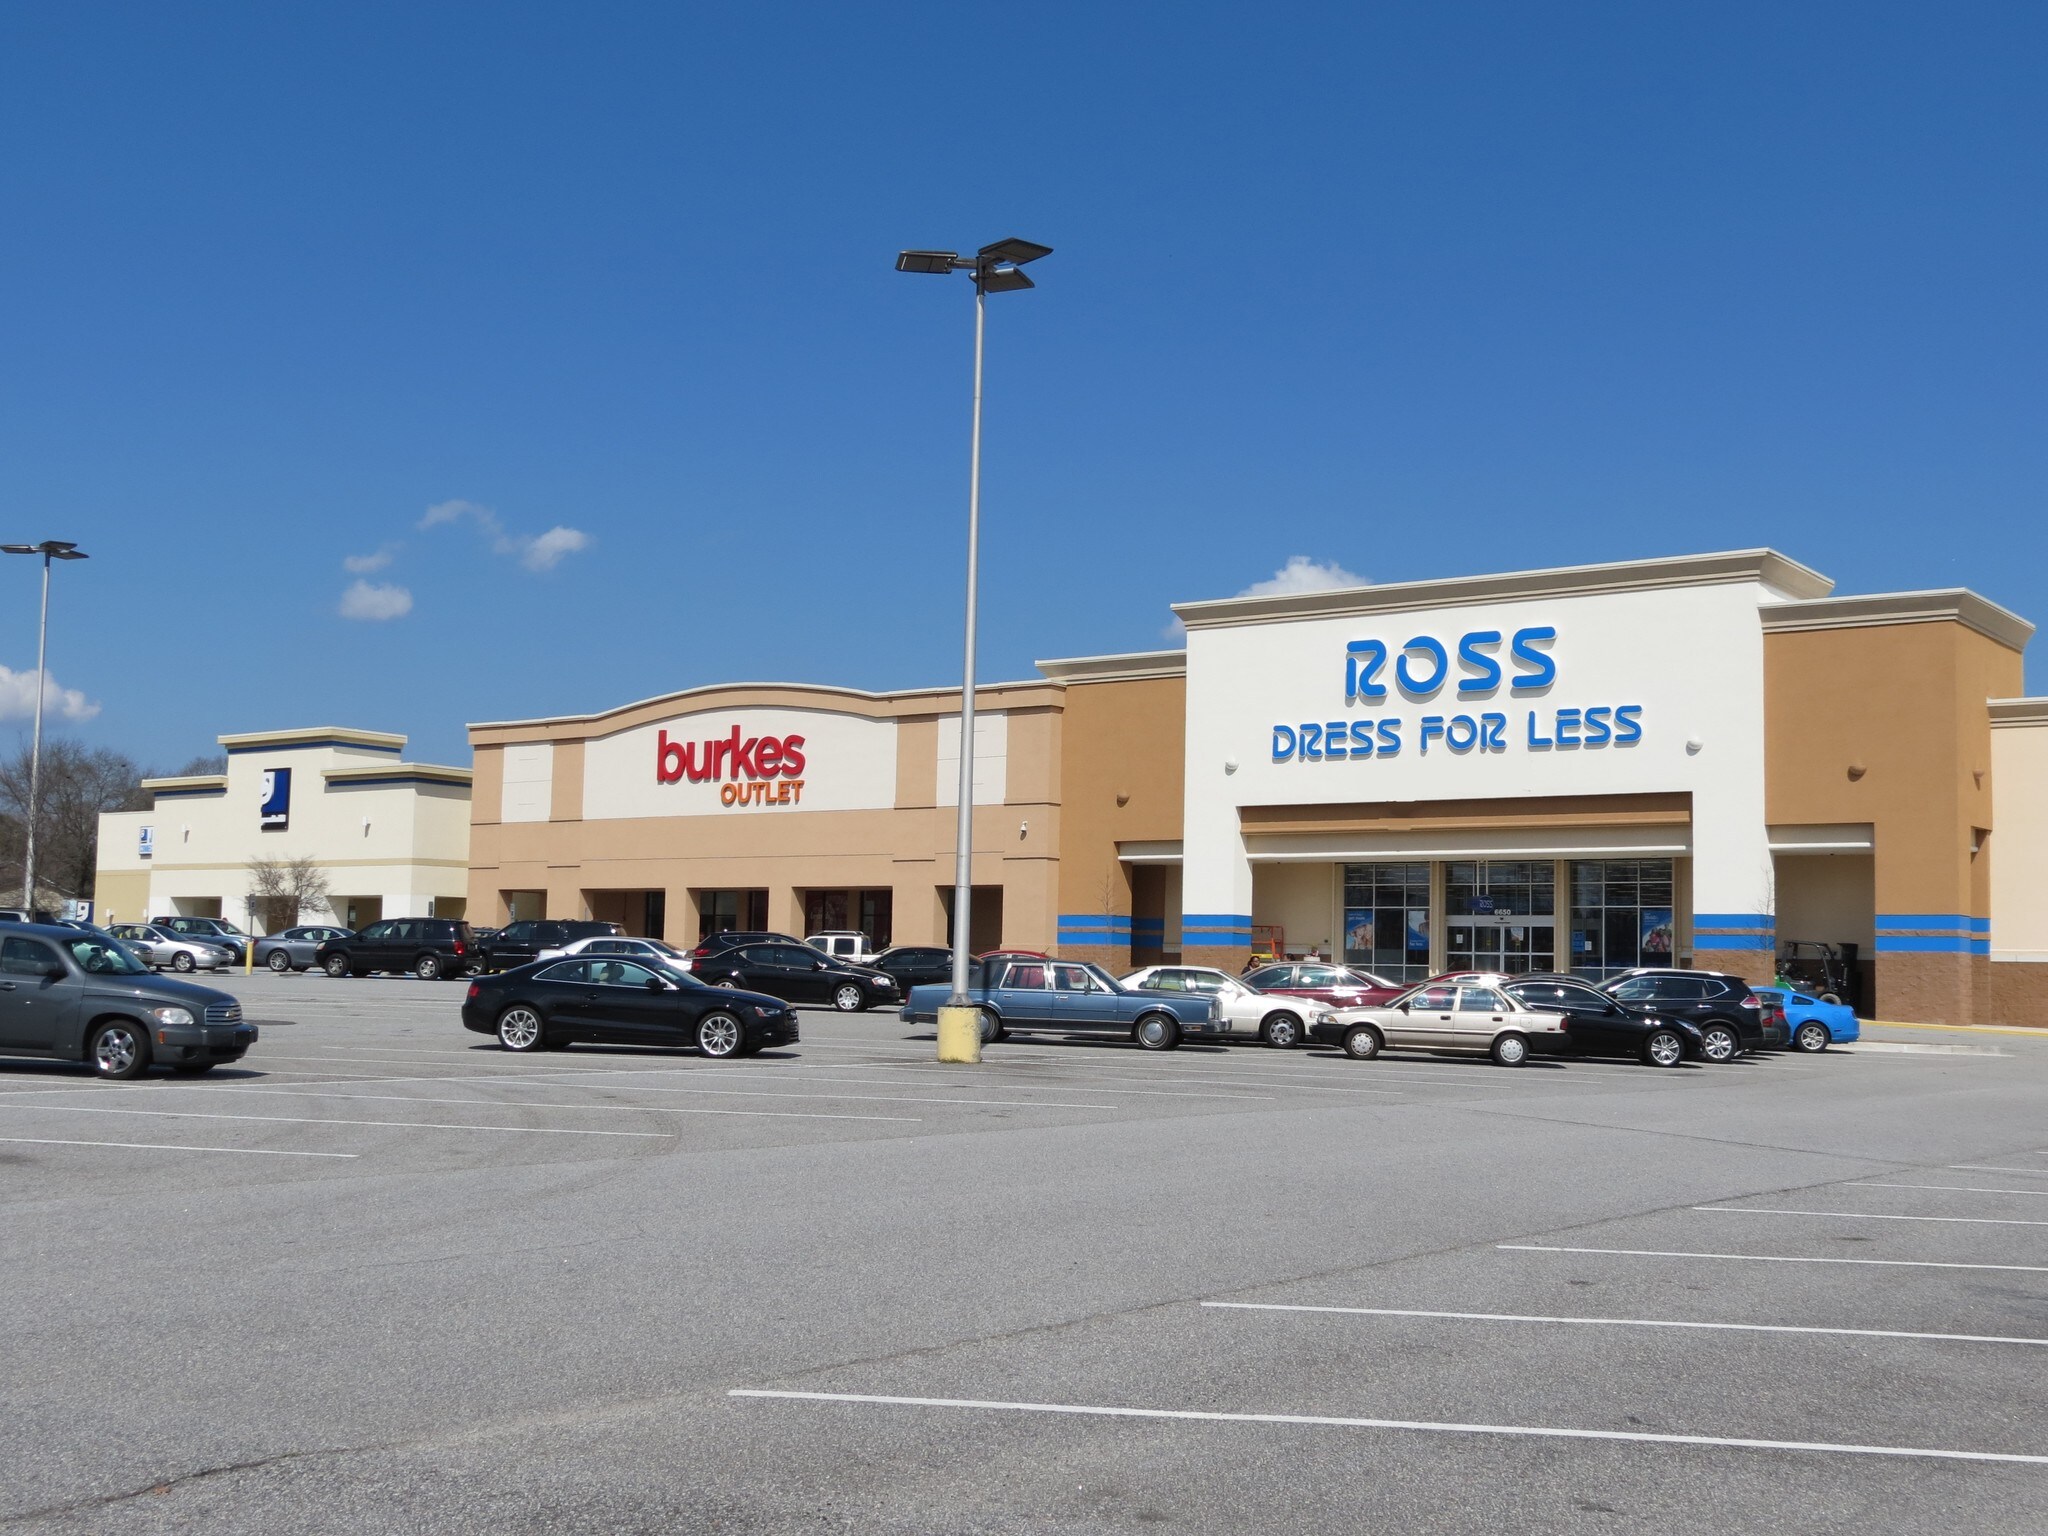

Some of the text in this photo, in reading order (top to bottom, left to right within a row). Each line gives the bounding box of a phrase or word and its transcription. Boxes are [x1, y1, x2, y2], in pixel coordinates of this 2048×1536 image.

[1345, 626, 1557, 698] ROSS
[657, 724, 806, 782] burkes
[1272, 705, 1643, 759] DRESS FOR LESS
[720, 780, 805, 804] OUTLET
